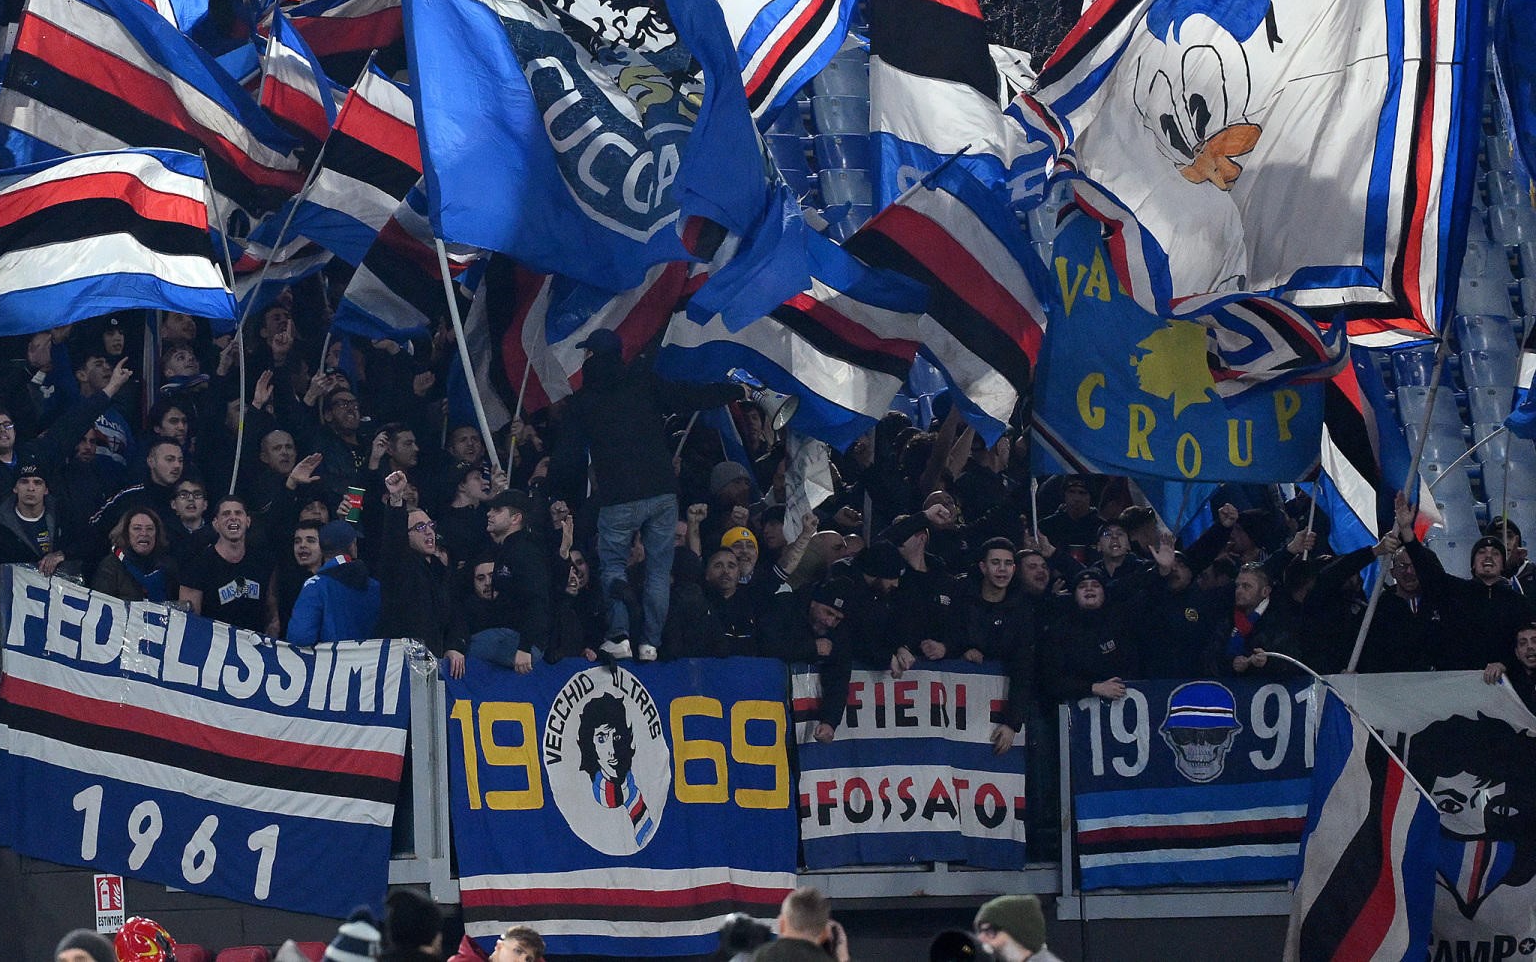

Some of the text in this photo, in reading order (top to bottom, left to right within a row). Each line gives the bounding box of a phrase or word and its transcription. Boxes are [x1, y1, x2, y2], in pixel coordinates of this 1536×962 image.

[1076, 372, 1302, 479] GROUP
[6, 564, 406, 716] FEDELISSIMI
[450, 694, 790, 810] 19 69
[546, 672, 595, 766] VECCHIO
[1077, 683, 1315, 777] 19 91
[72, 783, 281, 901] 1961
[816, 776, 1008, 829] FOSSATO
[98, 914, 124, 927] ESTINTORE
